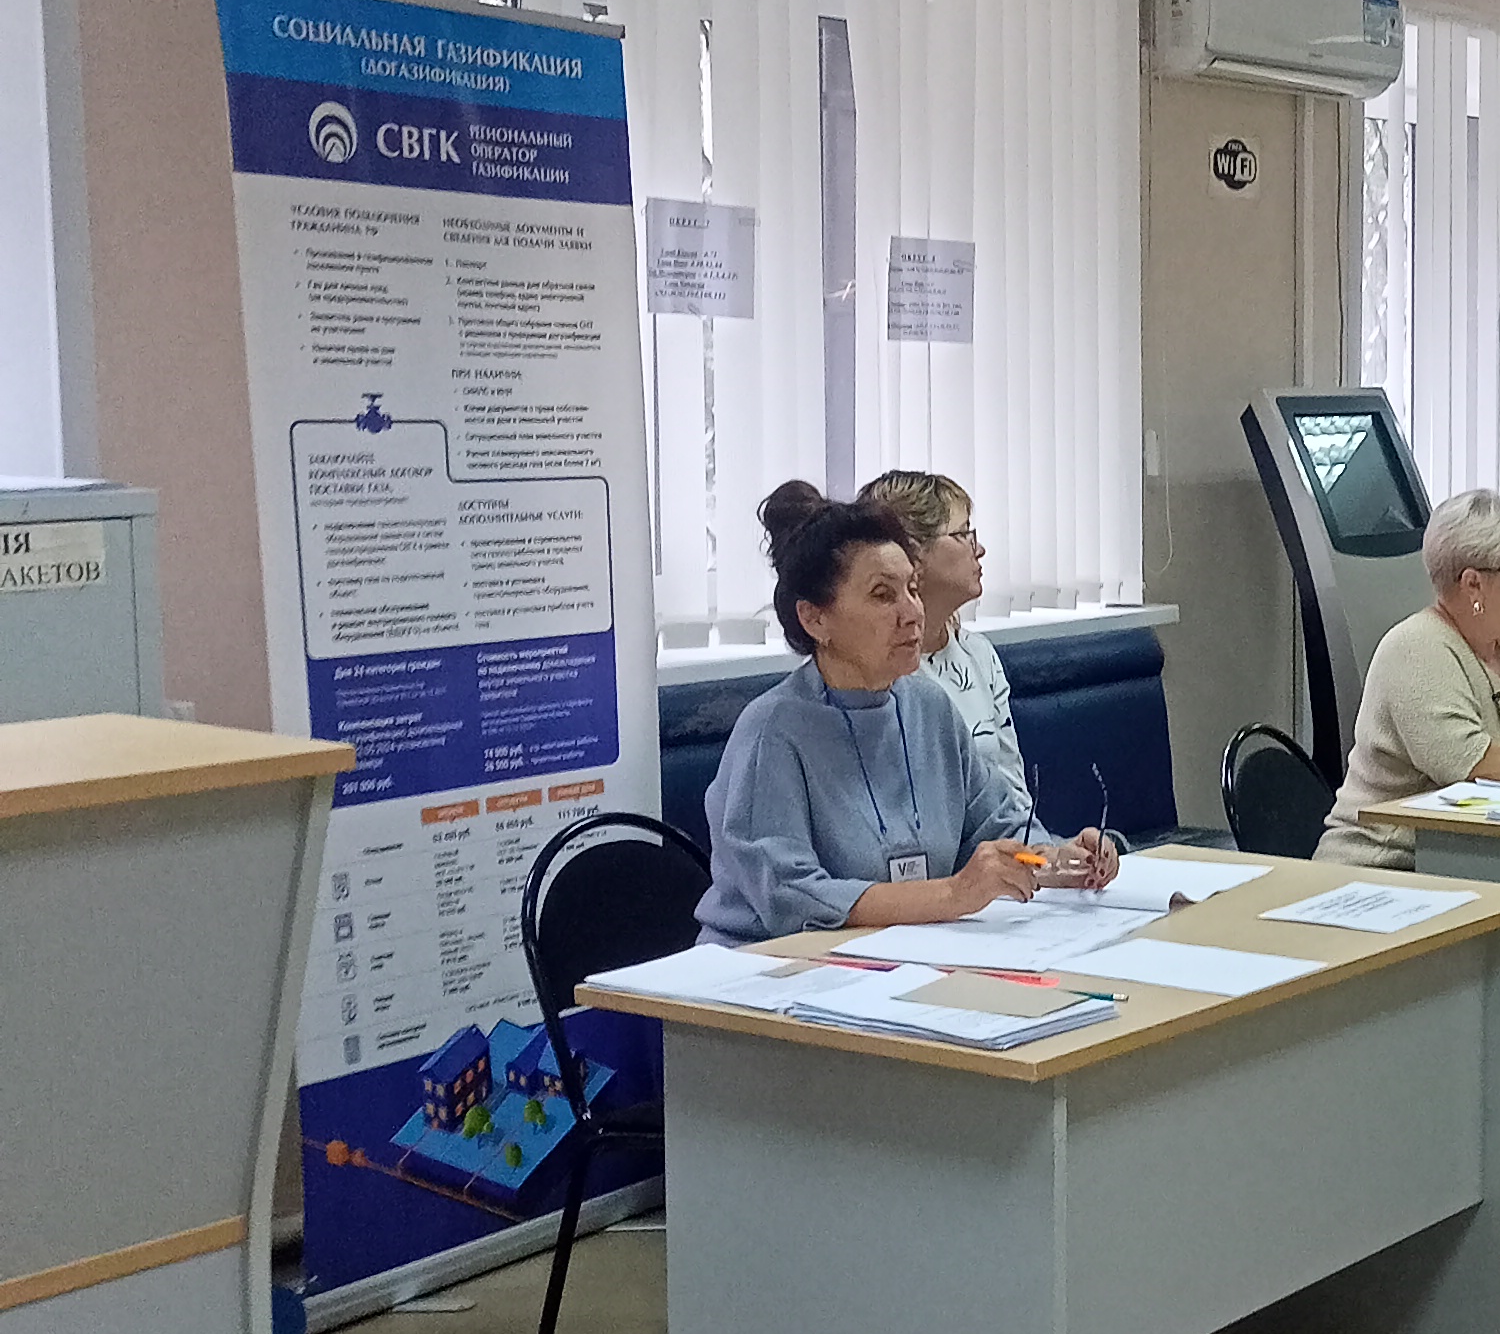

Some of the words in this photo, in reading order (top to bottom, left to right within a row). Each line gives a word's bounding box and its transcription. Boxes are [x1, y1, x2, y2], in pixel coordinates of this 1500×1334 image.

[272, 13, 426, 58] СОЦИАЛЬНАЯ
[436, 38, 583, 80] ГАЗИФИКАЦИЯ
[376, 121, 461, 165] СВГК
